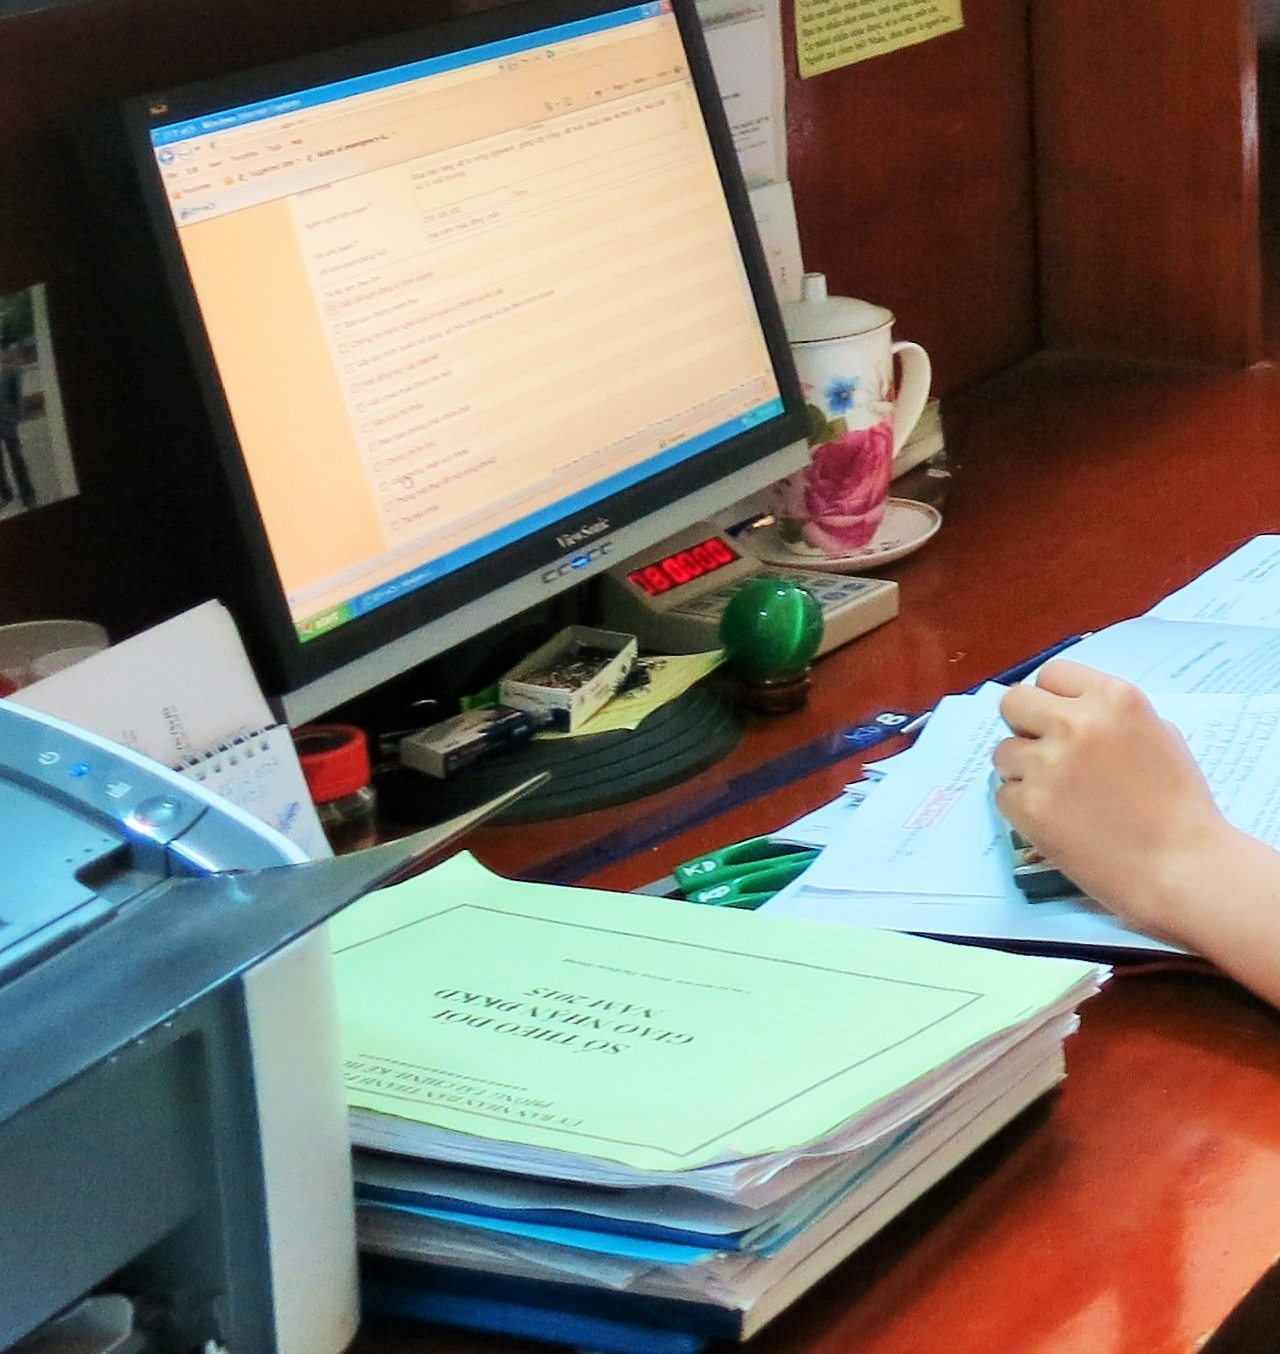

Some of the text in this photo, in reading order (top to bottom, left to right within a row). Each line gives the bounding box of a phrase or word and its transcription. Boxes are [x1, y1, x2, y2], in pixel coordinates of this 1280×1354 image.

[521, 986, 591, 1006] 2015
[494, 1023, 579, 1047] THEO
[612, 1023, 696, 1047] GIAO
